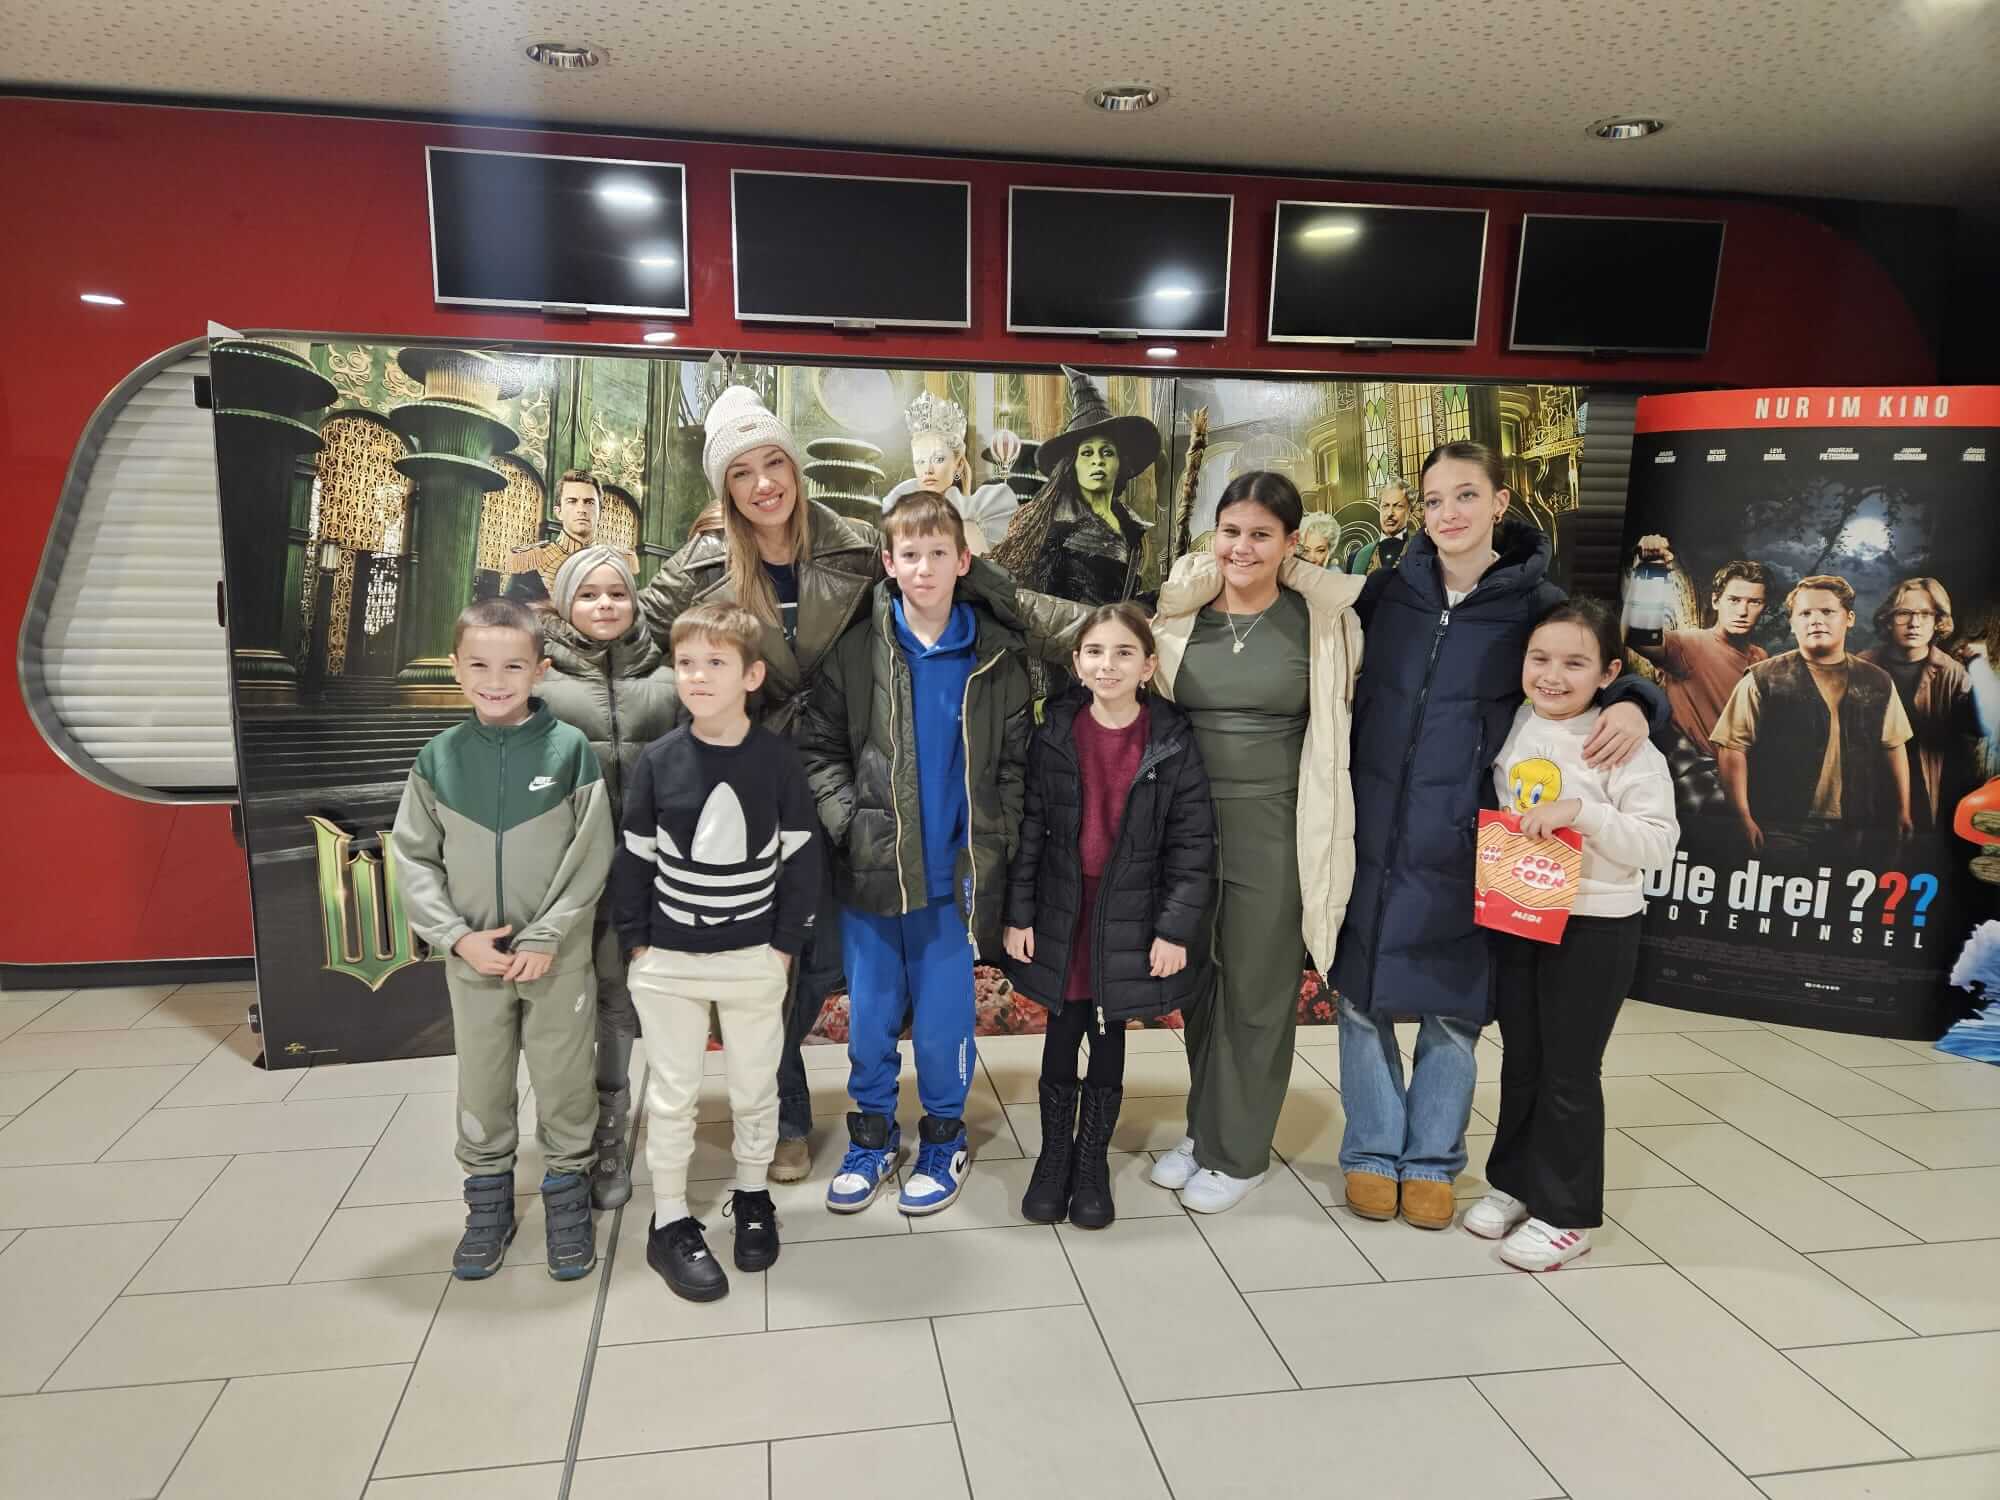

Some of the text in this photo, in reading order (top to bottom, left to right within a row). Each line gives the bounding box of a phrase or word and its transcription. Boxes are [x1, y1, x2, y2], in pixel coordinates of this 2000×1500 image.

[1755, 395, 1950, 420] NUR IM KINO
[1521, 855, 1562, 872] POP
[1511, 867, 1566, 888] CORN
[1728, 860, 1833, 919] drei
[1846, 869, 1939, 928] ???
